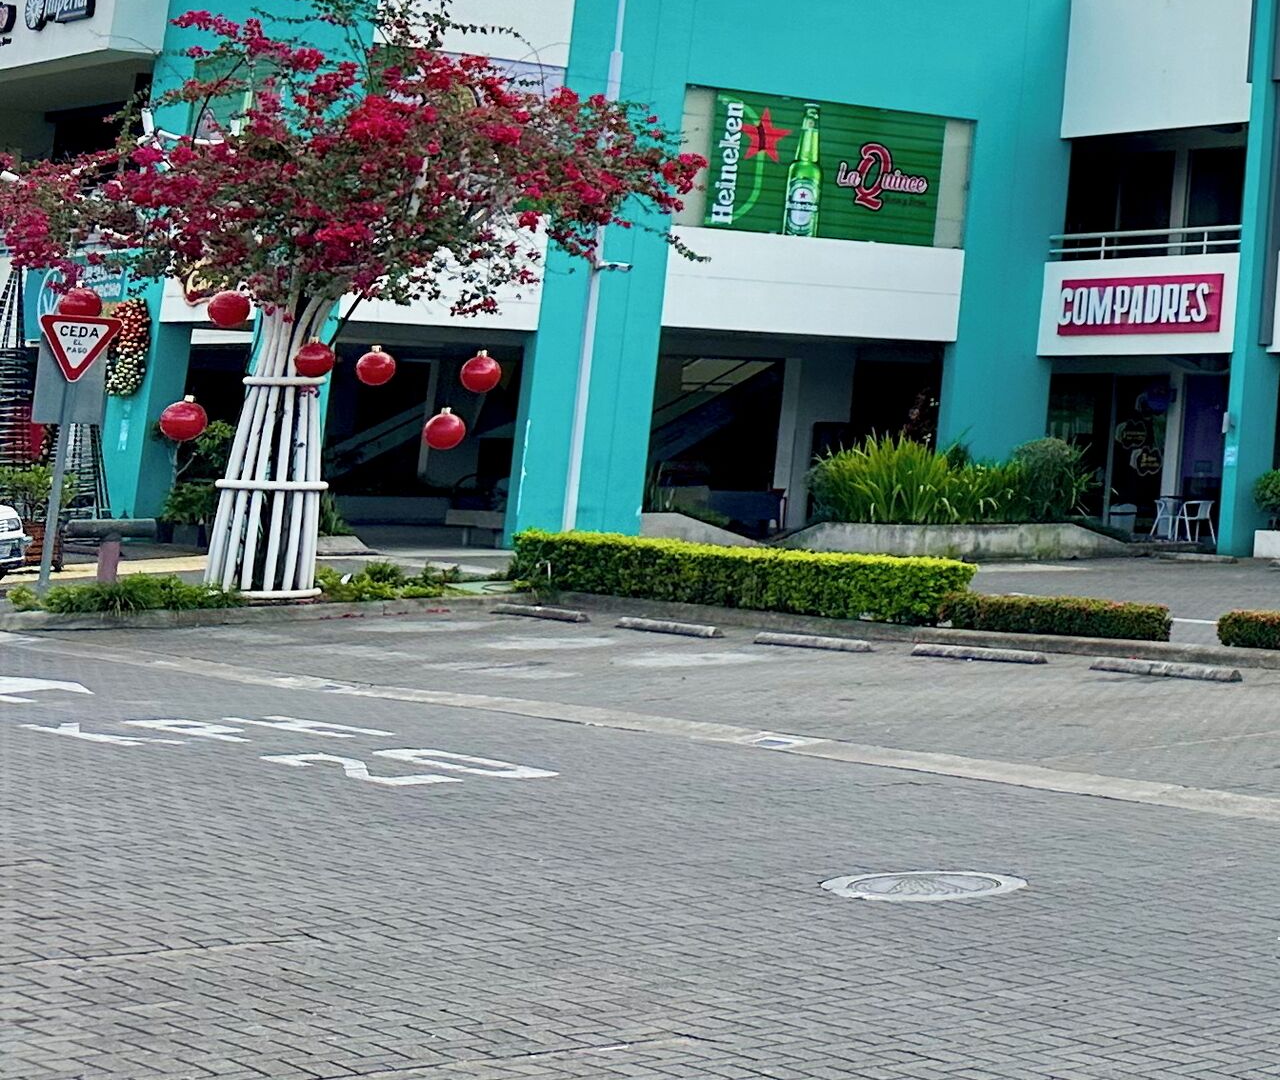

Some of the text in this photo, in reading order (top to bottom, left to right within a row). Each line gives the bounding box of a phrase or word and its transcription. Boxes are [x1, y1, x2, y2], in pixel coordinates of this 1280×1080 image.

[711, 100, 744, 224] Heineken
[837, 143, 928, 211] La Quince
[1058, 282, 1210, 326] COMPADRES
[60, 325, 99, 338] CEDA
[73, 338, 83, 346] EL
[66, 346, 88, 354] PASO
[19, 715, 397, 746] KPH
[259, 748, 561, 786] 20
